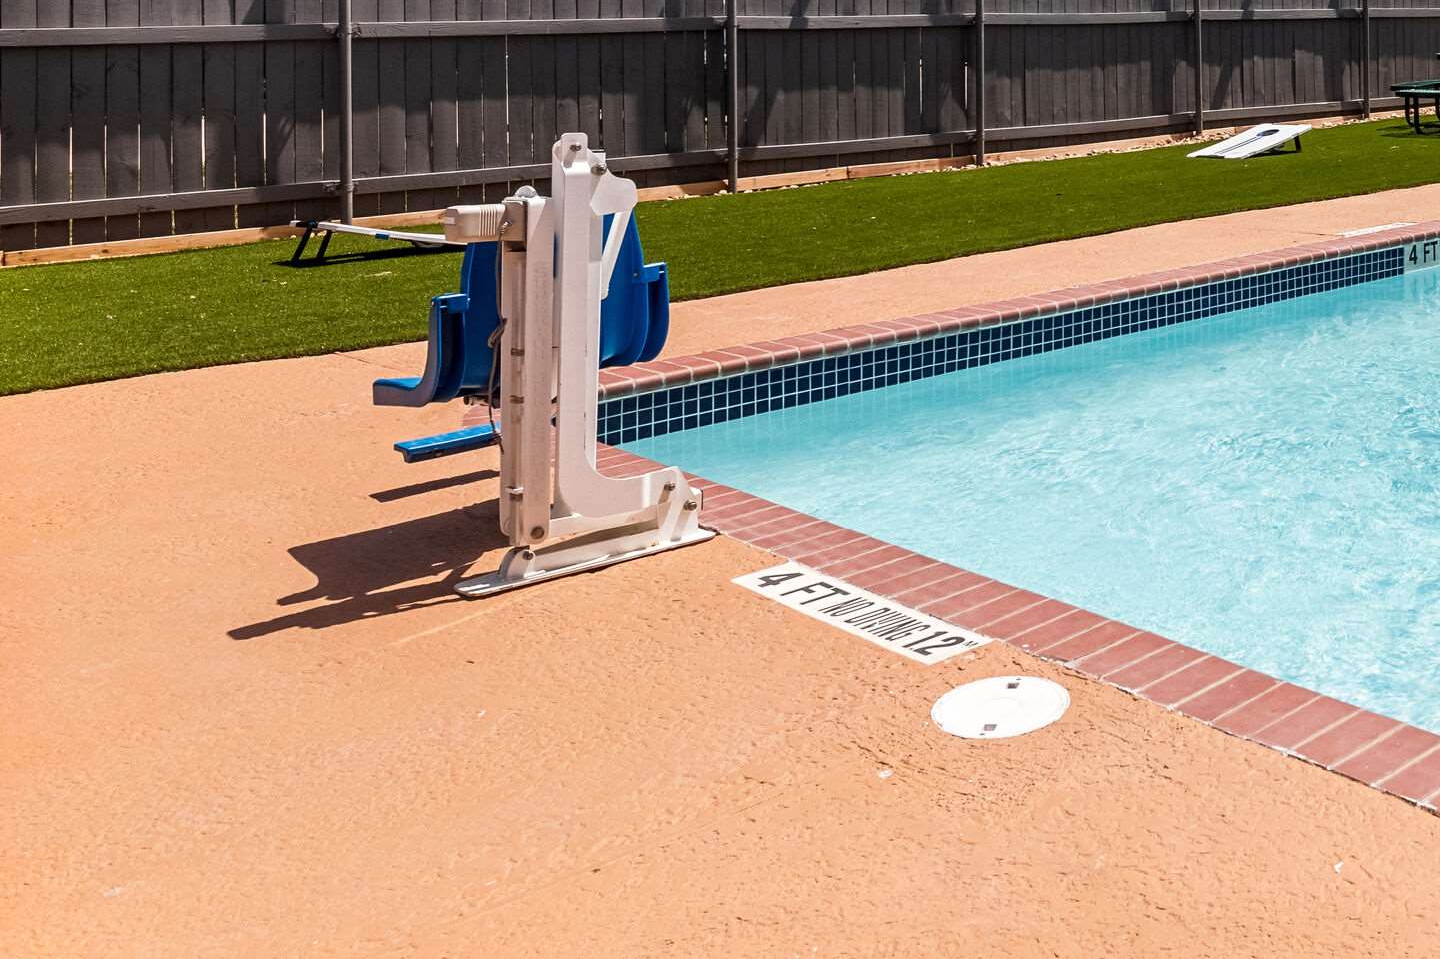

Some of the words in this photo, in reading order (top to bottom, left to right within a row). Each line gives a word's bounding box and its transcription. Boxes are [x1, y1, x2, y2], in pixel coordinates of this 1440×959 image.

[1408, 244, 1418, 265] 4
[1423, 241, 1438, 264] FT
[758, 572, 804, 587] 4
[779, 581, 851, 605] FT
[817, 596, 875, 617] NO
[844, 607, 931, 642] DIVING
